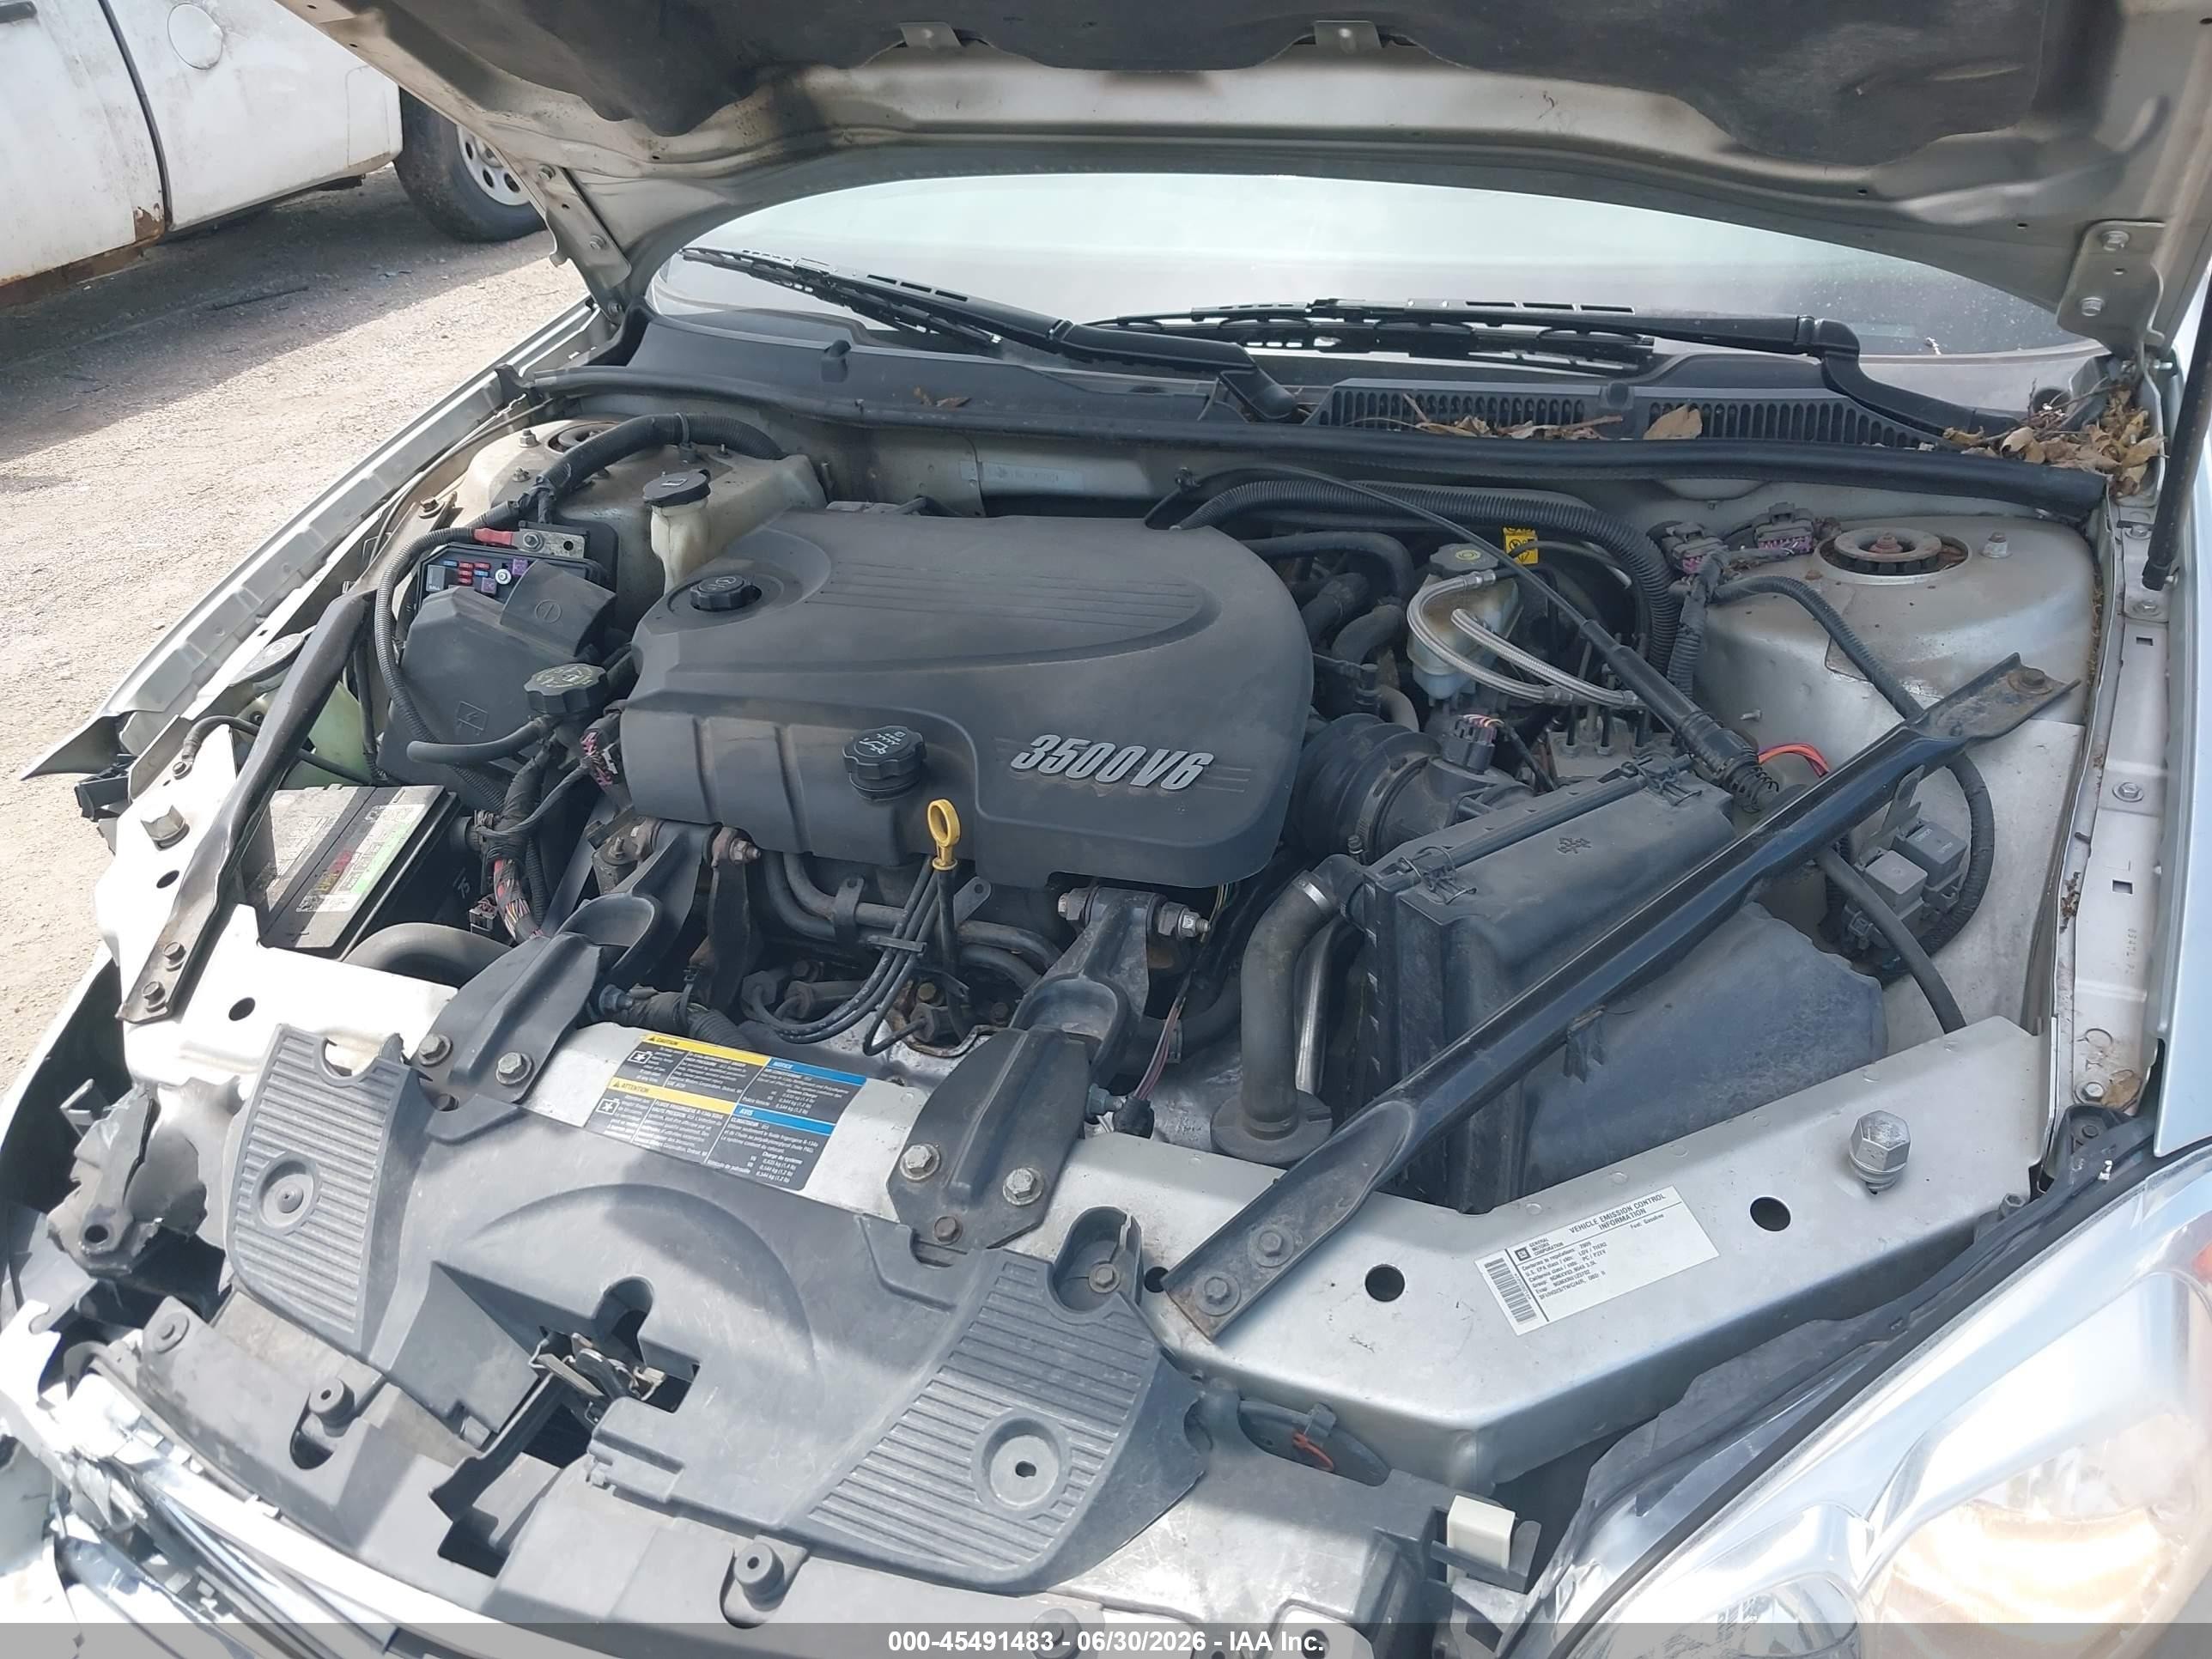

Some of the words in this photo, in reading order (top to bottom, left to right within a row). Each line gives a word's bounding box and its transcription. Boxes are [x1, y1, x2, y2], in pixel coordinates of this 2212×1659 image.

[1569, 1218, 1599, 1233] VEHICLE
[1599, 1206, 1633, 1222] EMISSION
[1633, 1193, 1667, 1209] CONTROL
[1598, 1208, 1646, 1231] INFORMATION
[1534, 1242, 1565, 1255] CORPORATION
